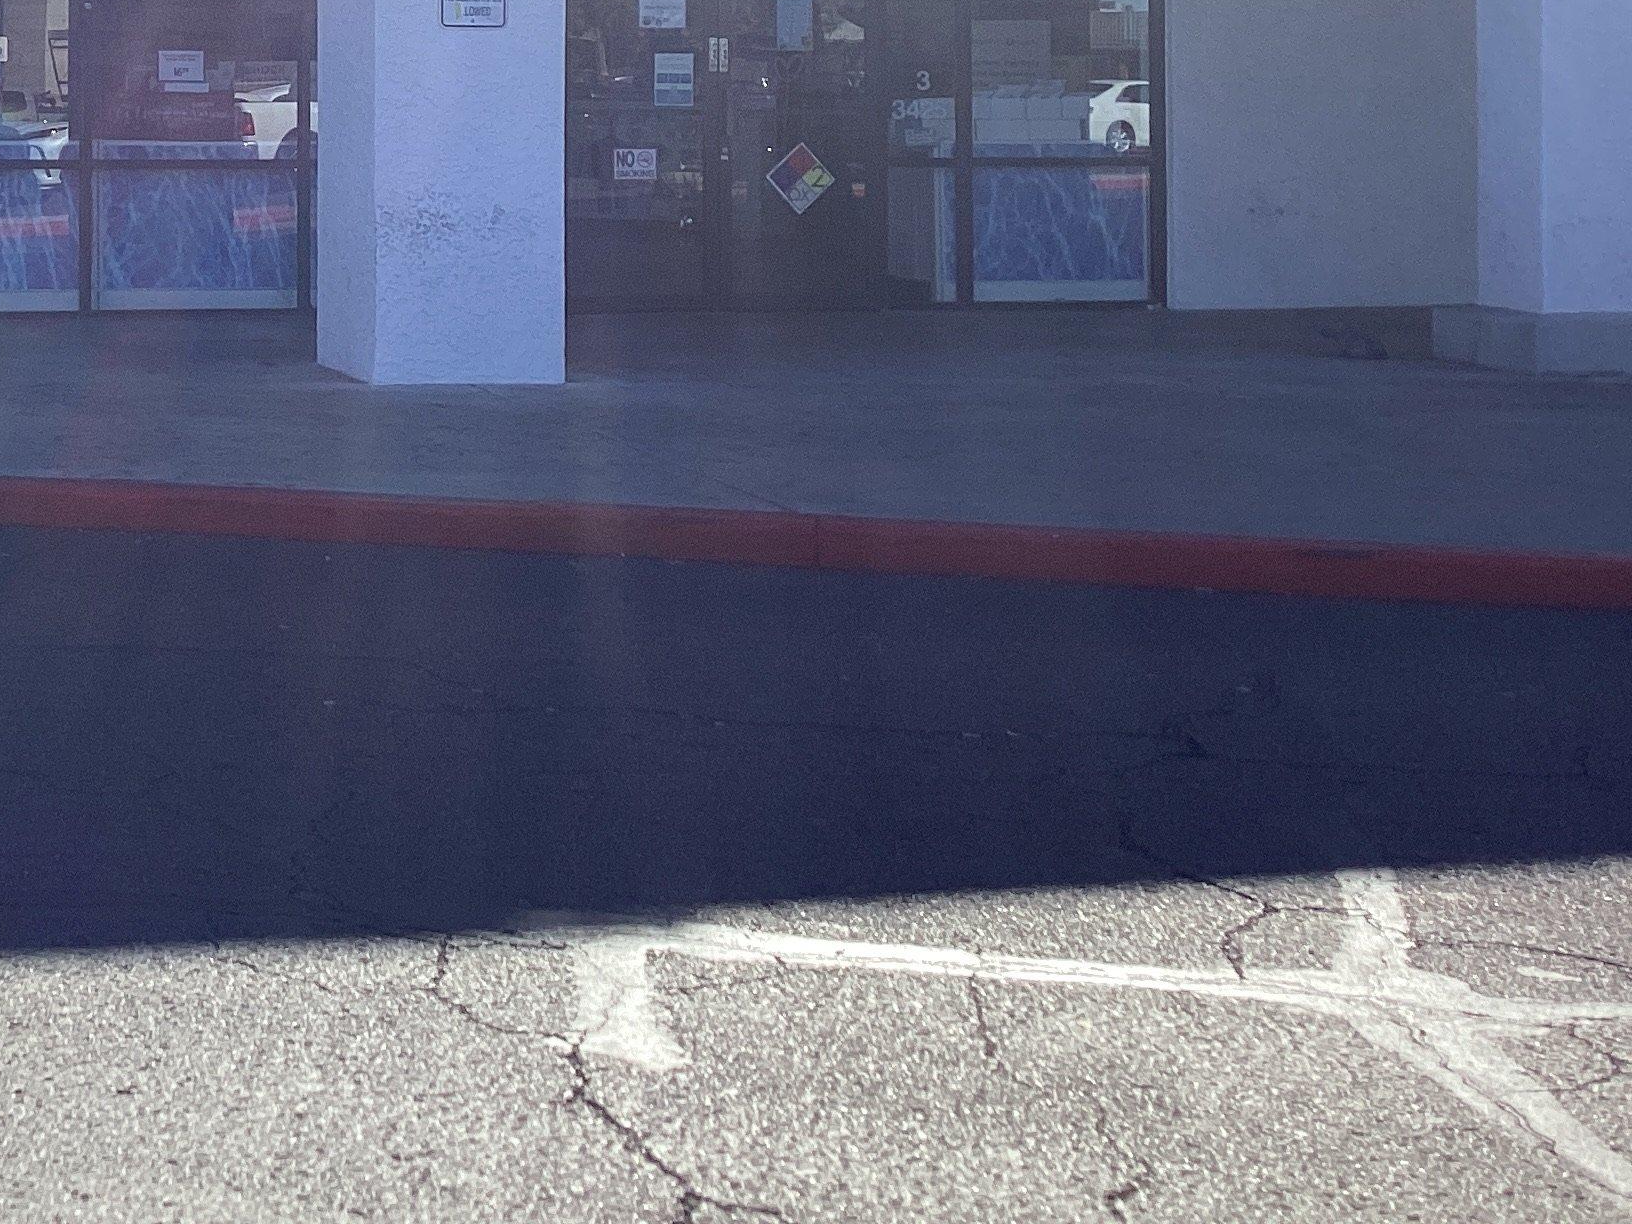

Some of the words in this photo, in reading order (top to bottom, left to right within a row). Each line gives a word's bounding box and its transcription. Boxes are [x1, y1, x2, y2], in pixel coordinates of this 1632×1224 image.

[916, 70, 931, 91] 3
[616, 150, 635, 168] NO
[811, 165, 827, 187] 2
